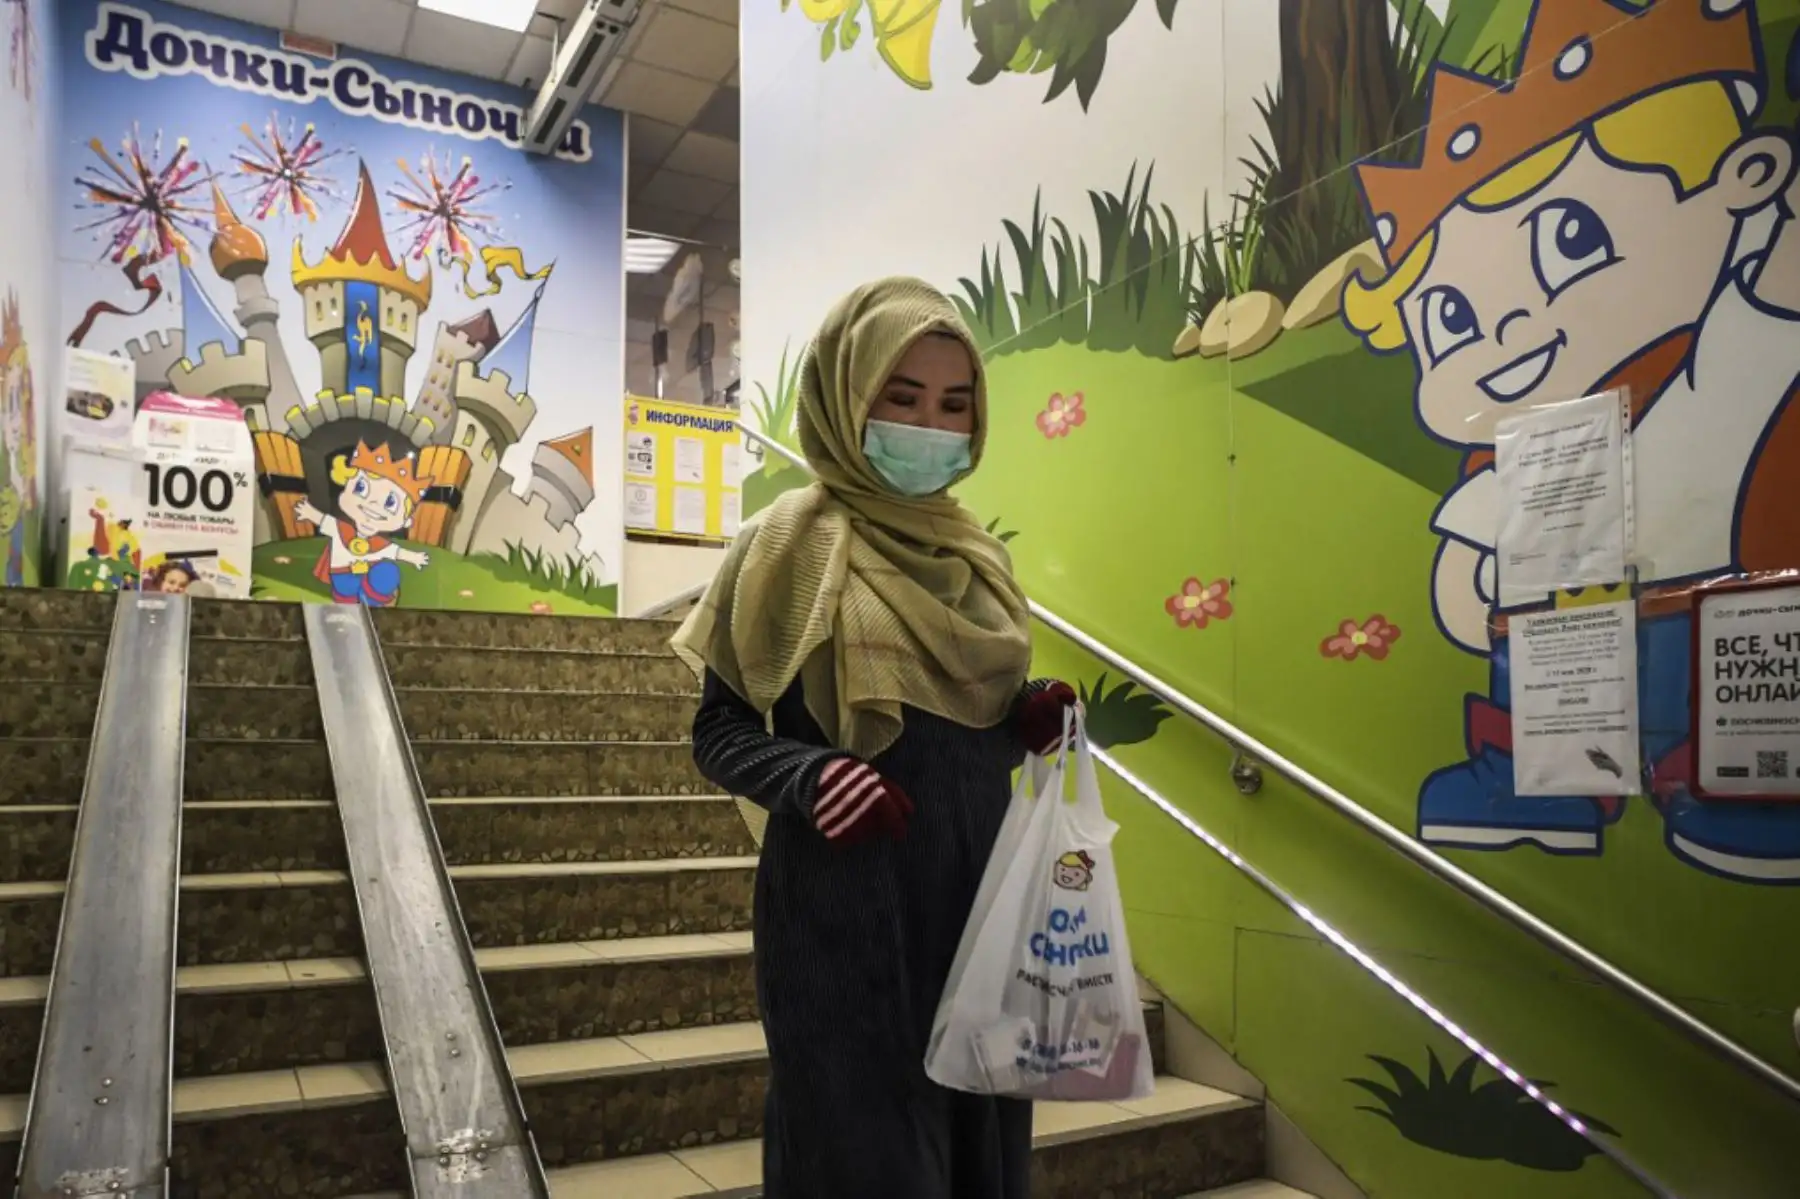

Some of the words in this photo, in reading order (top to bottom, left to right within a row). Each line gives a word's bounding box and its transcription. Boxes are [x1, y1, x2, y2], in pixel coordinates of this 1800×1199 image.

[96, 11, 585, 157] Дочки-Сыночи
[646, 409, 734, 432] ИНФОРМАЦИЯ
[1714, 634, 1768, 658] ВСЕ,
[1715, 657, 1799, 680] НУЖН
